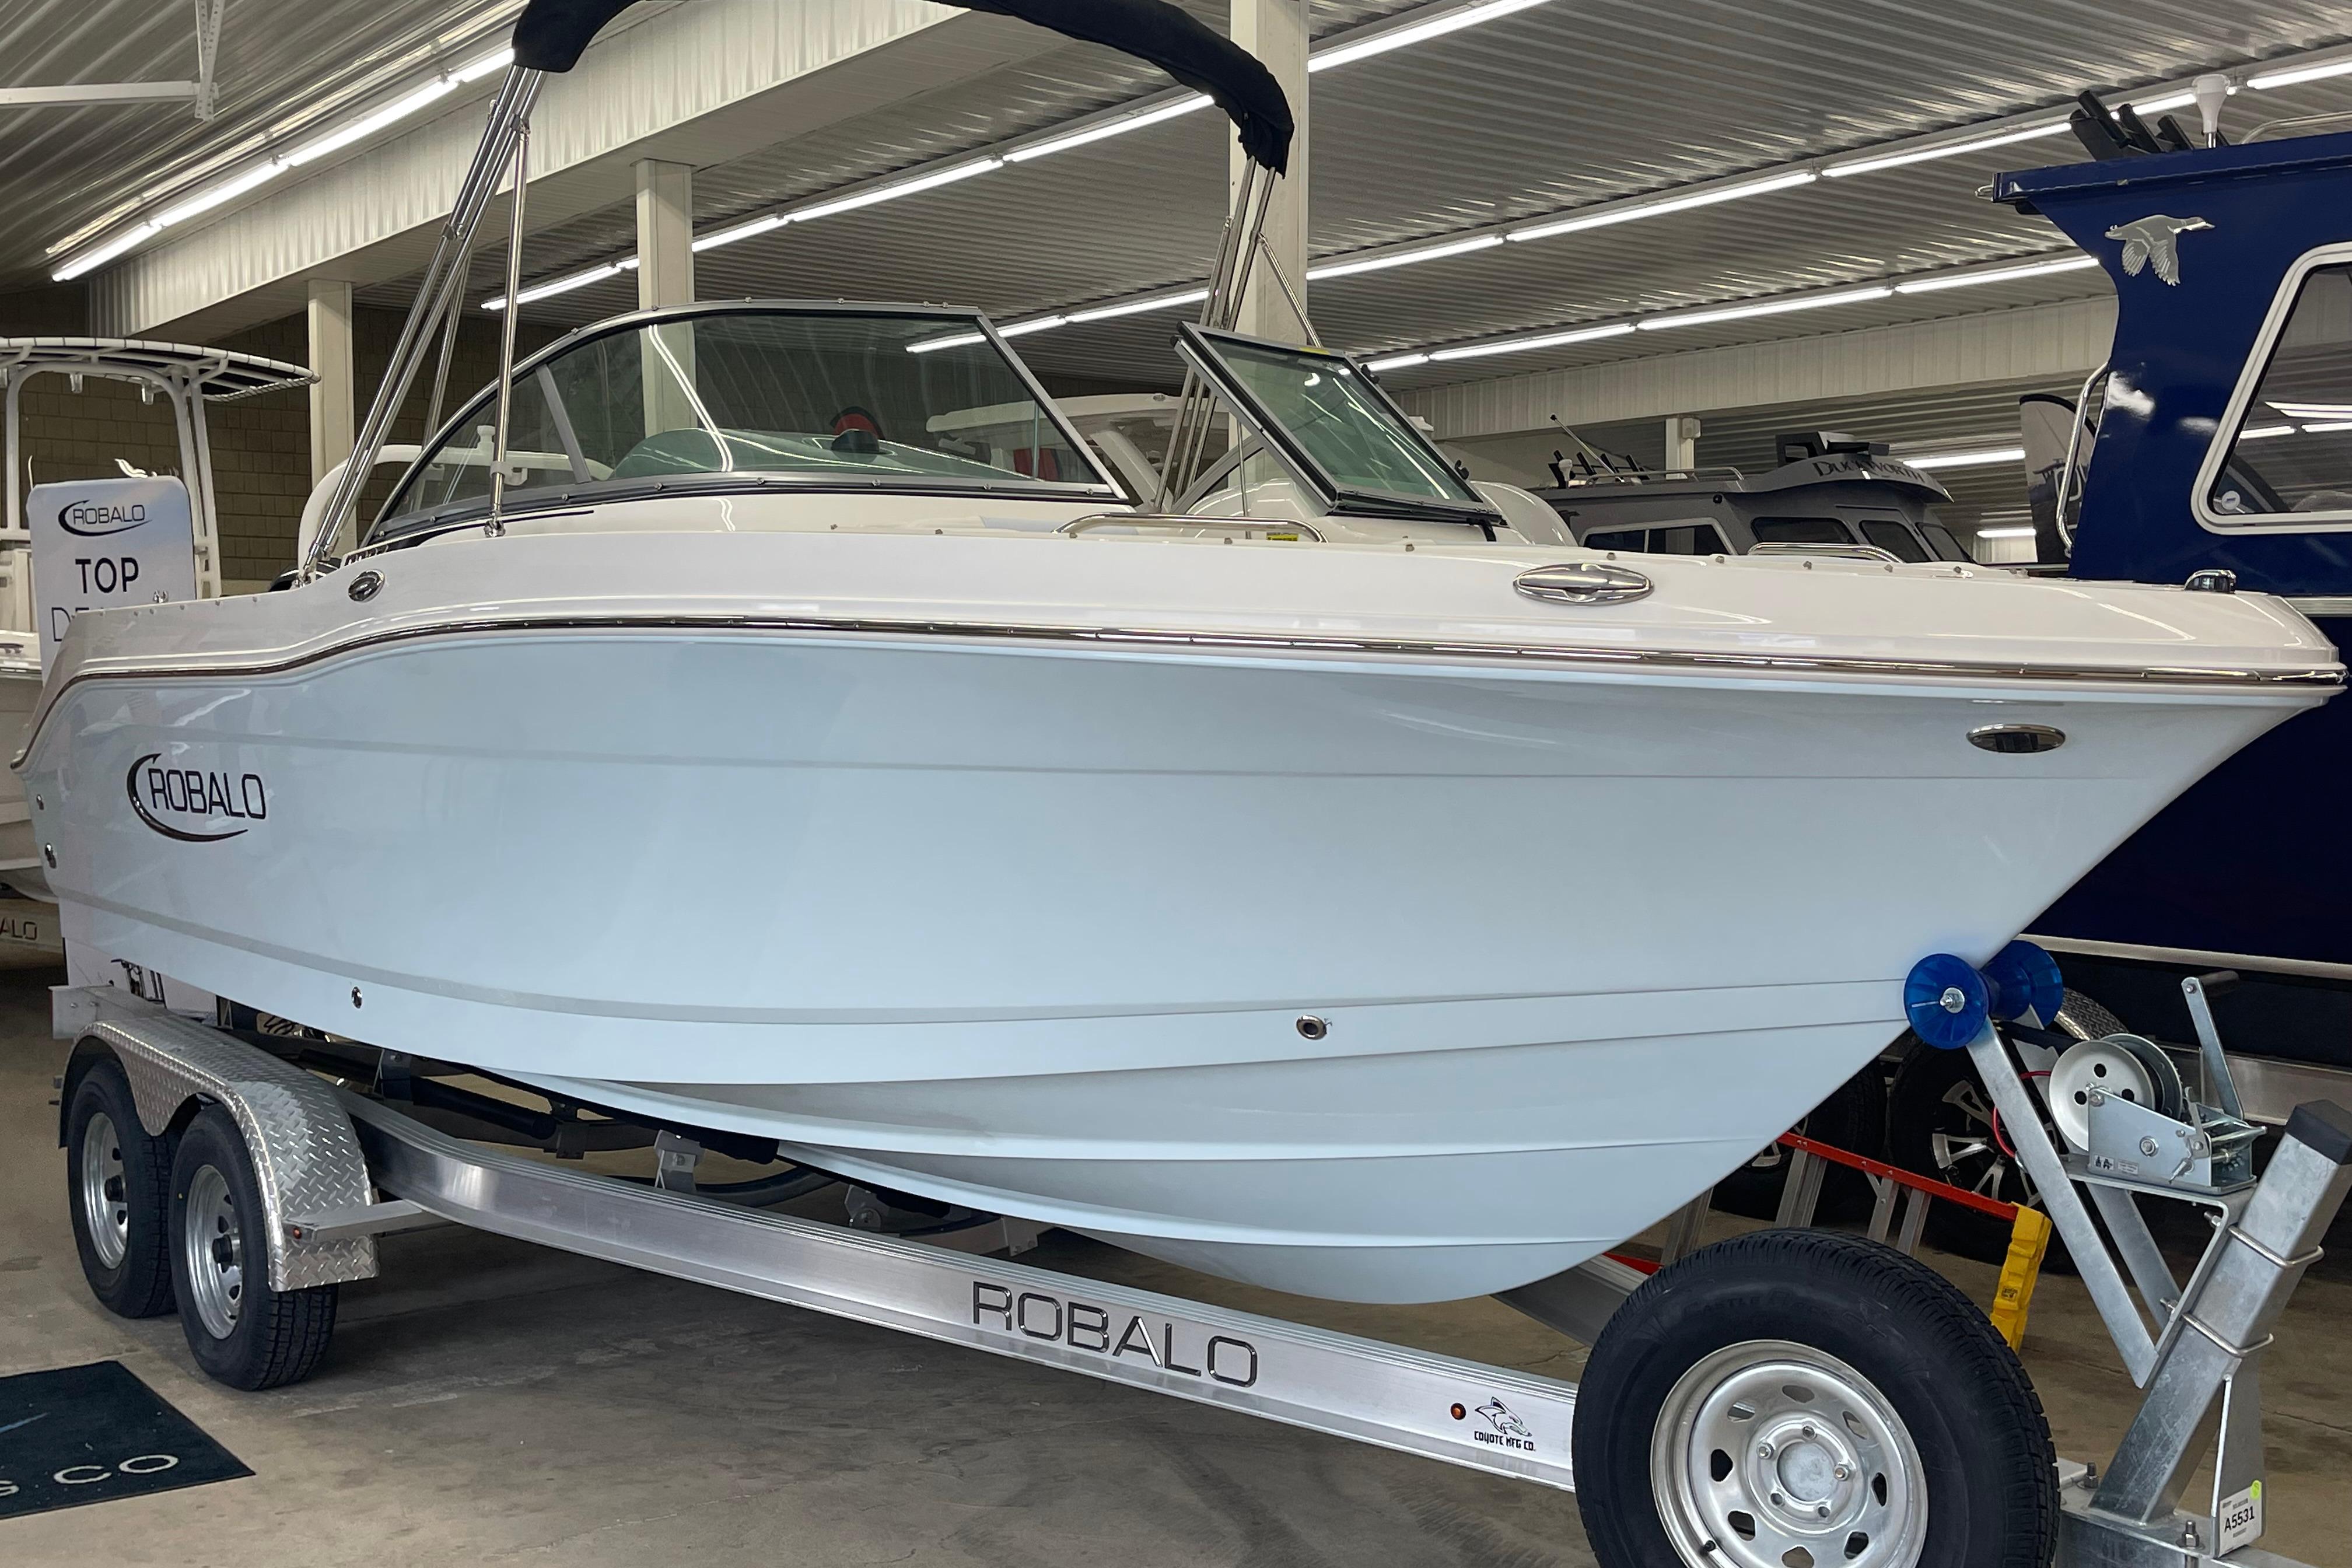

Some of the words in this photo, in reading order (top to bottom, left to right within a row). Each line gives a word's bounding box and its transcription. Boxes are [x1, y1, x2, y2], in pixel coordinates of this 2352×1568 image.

[73, 504, 145, 525] ROBALO
[75, 556, 139, 594] TOP
[148, 768, 266, 820] ROBALO
[973, 1281, 1258, 1388] ROBALO
[1474, 1430, 1504, 1446] COYOTE
[1506, 1437, 1522, 1448] MFG
[54, 1454, 178, 1485] CO
[2224, 1506, 2255, 1533] A5531
